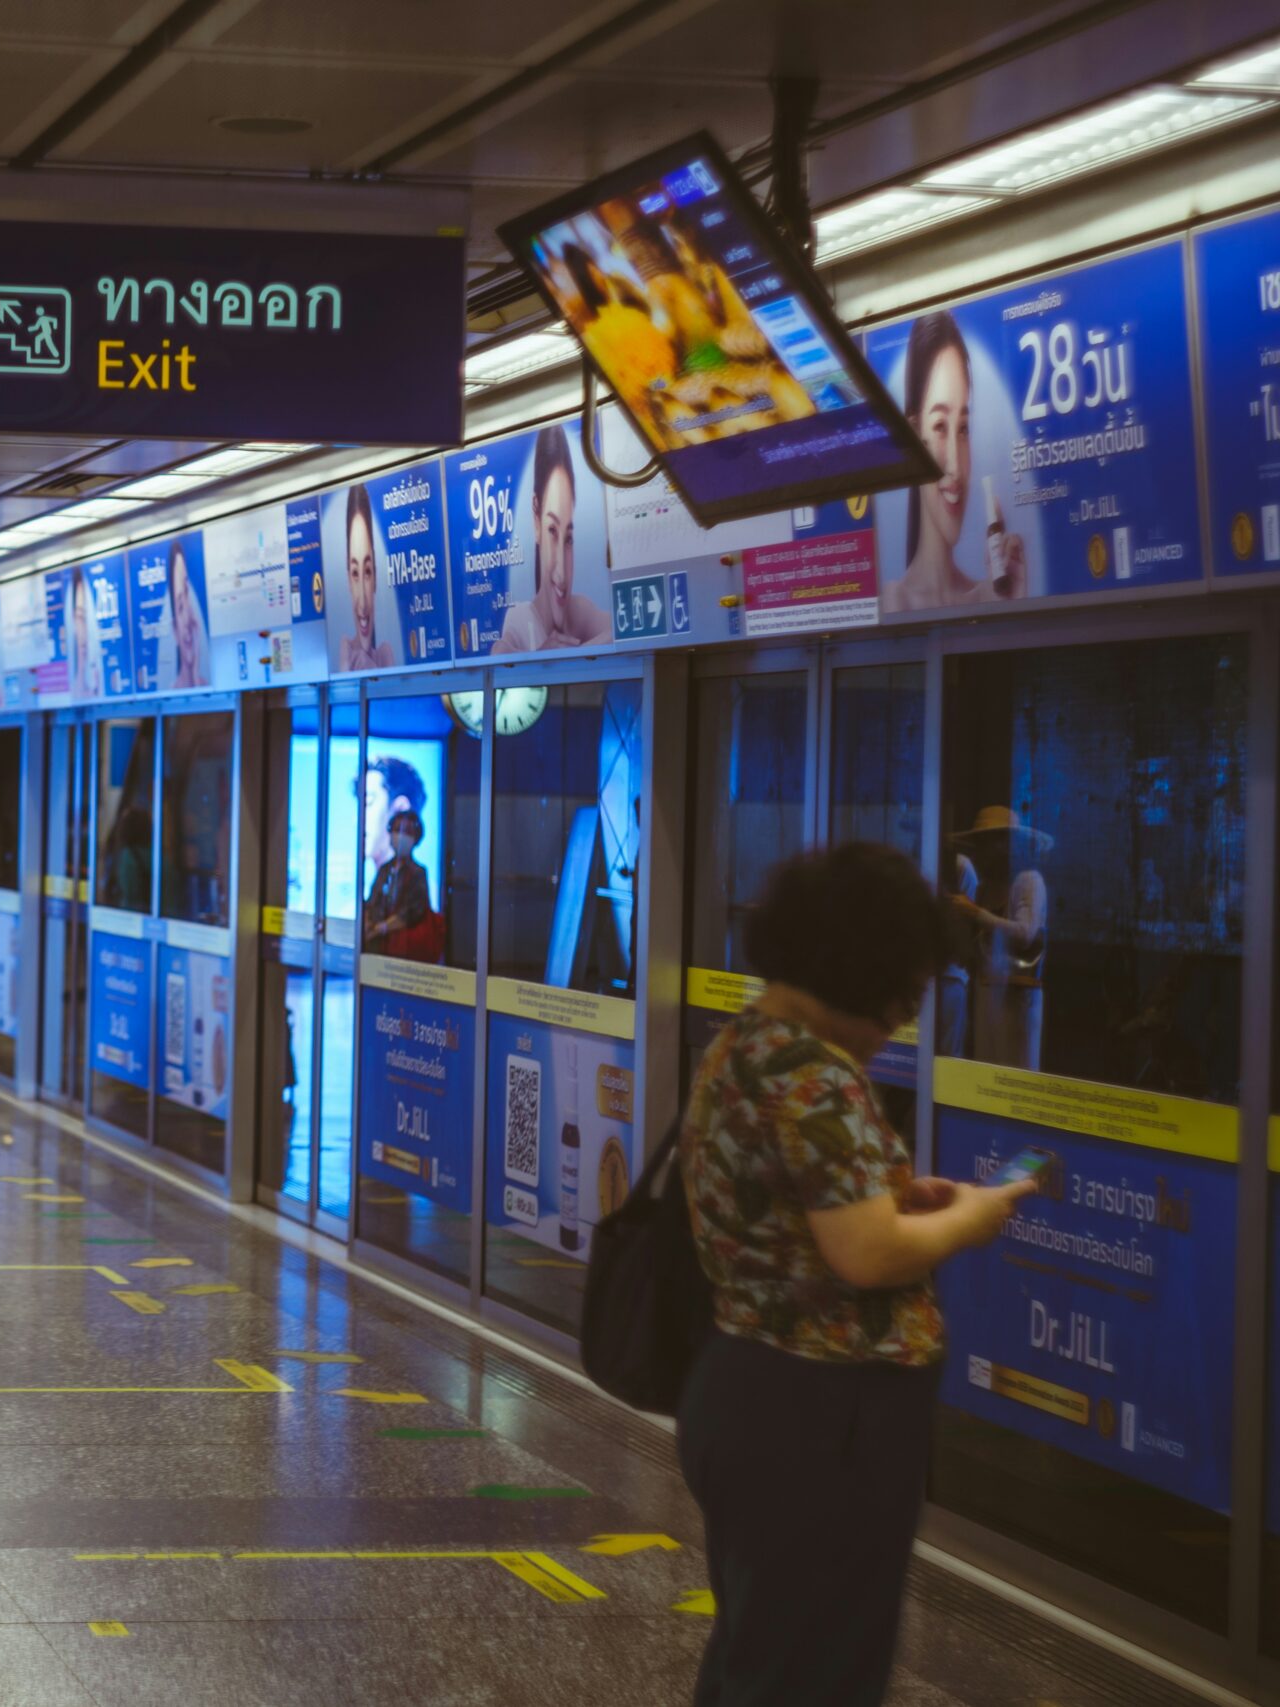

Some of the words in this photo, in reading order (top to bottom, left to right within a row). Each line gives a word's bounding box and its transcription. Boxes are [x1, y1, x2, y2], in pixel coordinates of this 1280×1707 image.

[97, 276, 341, 329] ทางออก
[98, 339, 196, 391] Exit
[1019, 323, 1077, 420] 28
[387, 549, 436, 587] HYA-Base
